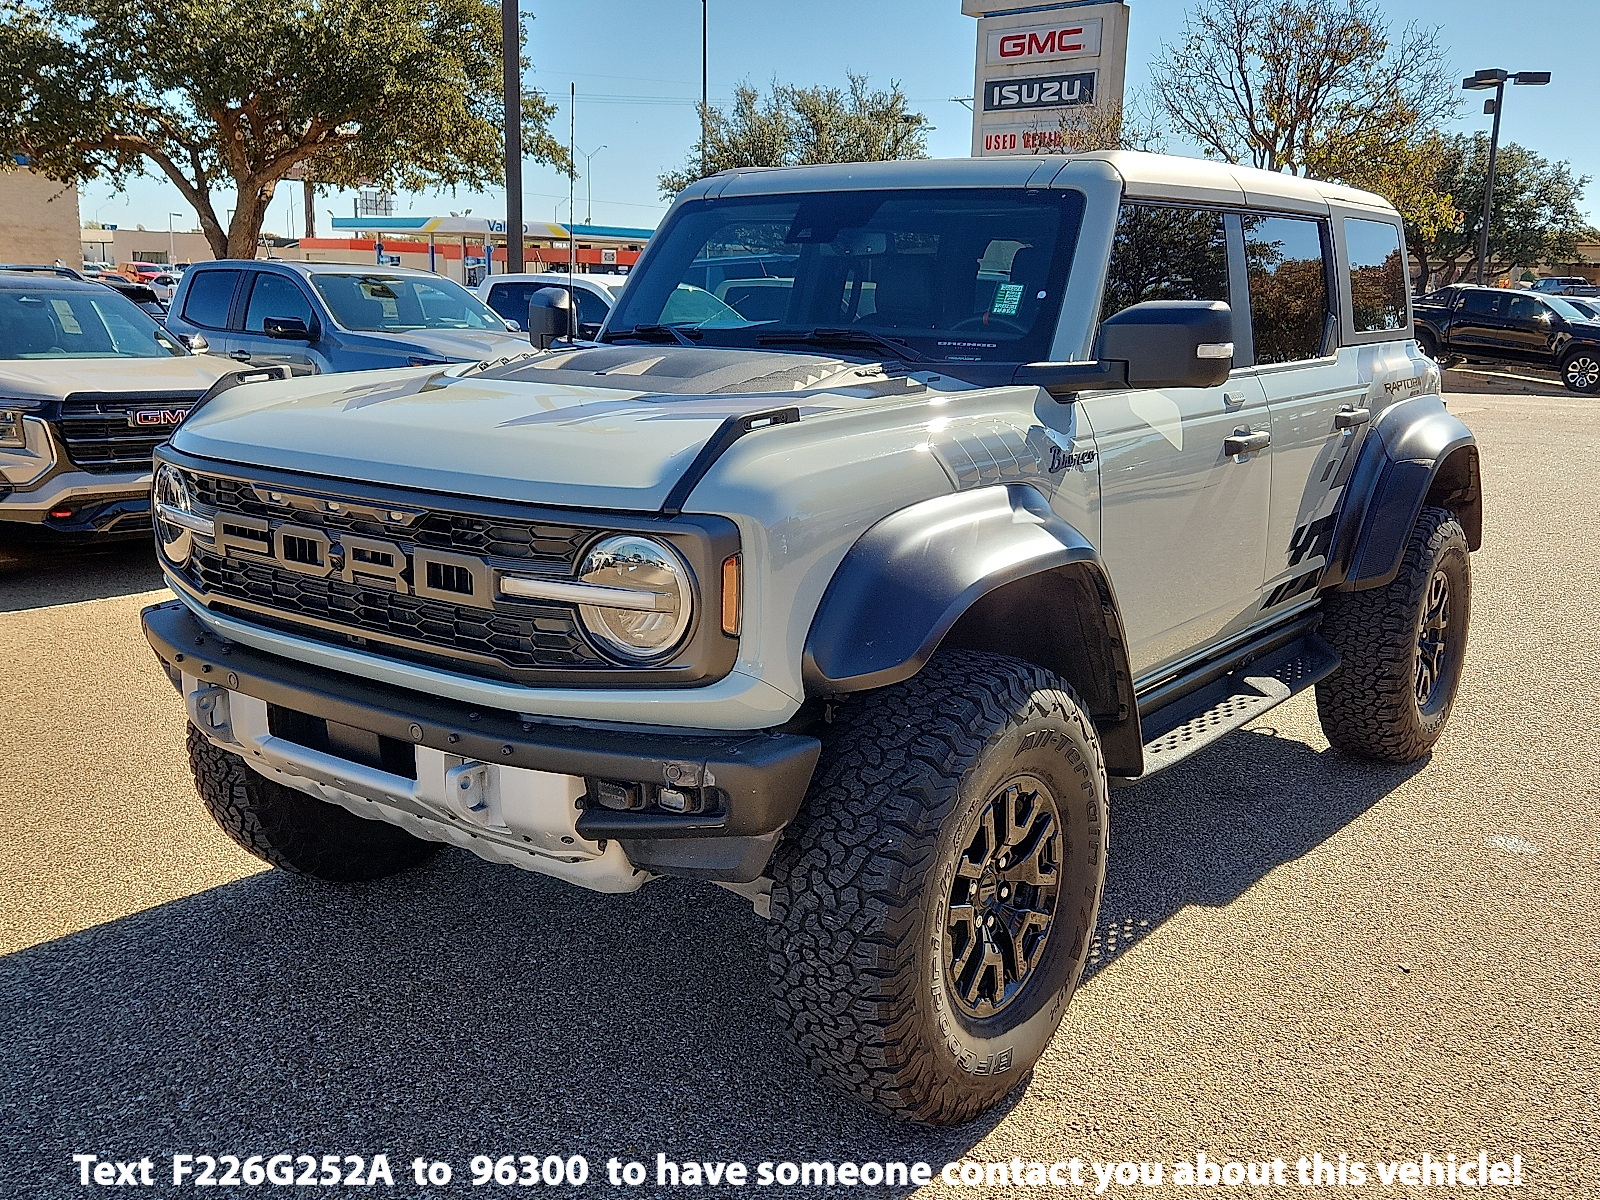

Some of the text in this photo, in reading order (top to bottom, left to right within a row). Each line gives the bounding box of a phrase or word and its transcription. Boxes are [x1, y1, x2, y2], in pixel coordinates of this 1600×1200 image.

[999, 27, 1084, 58] GMC
[993, 79, 1081, 106] ISUZU
[985, 133, 1017, 150] USED
[487, 219, 529, 234] Valo
[136, 409, 190, 425] GM
[1048, 446, 1099, 473] Bronco
[214, 510, 495, 610] FORD
